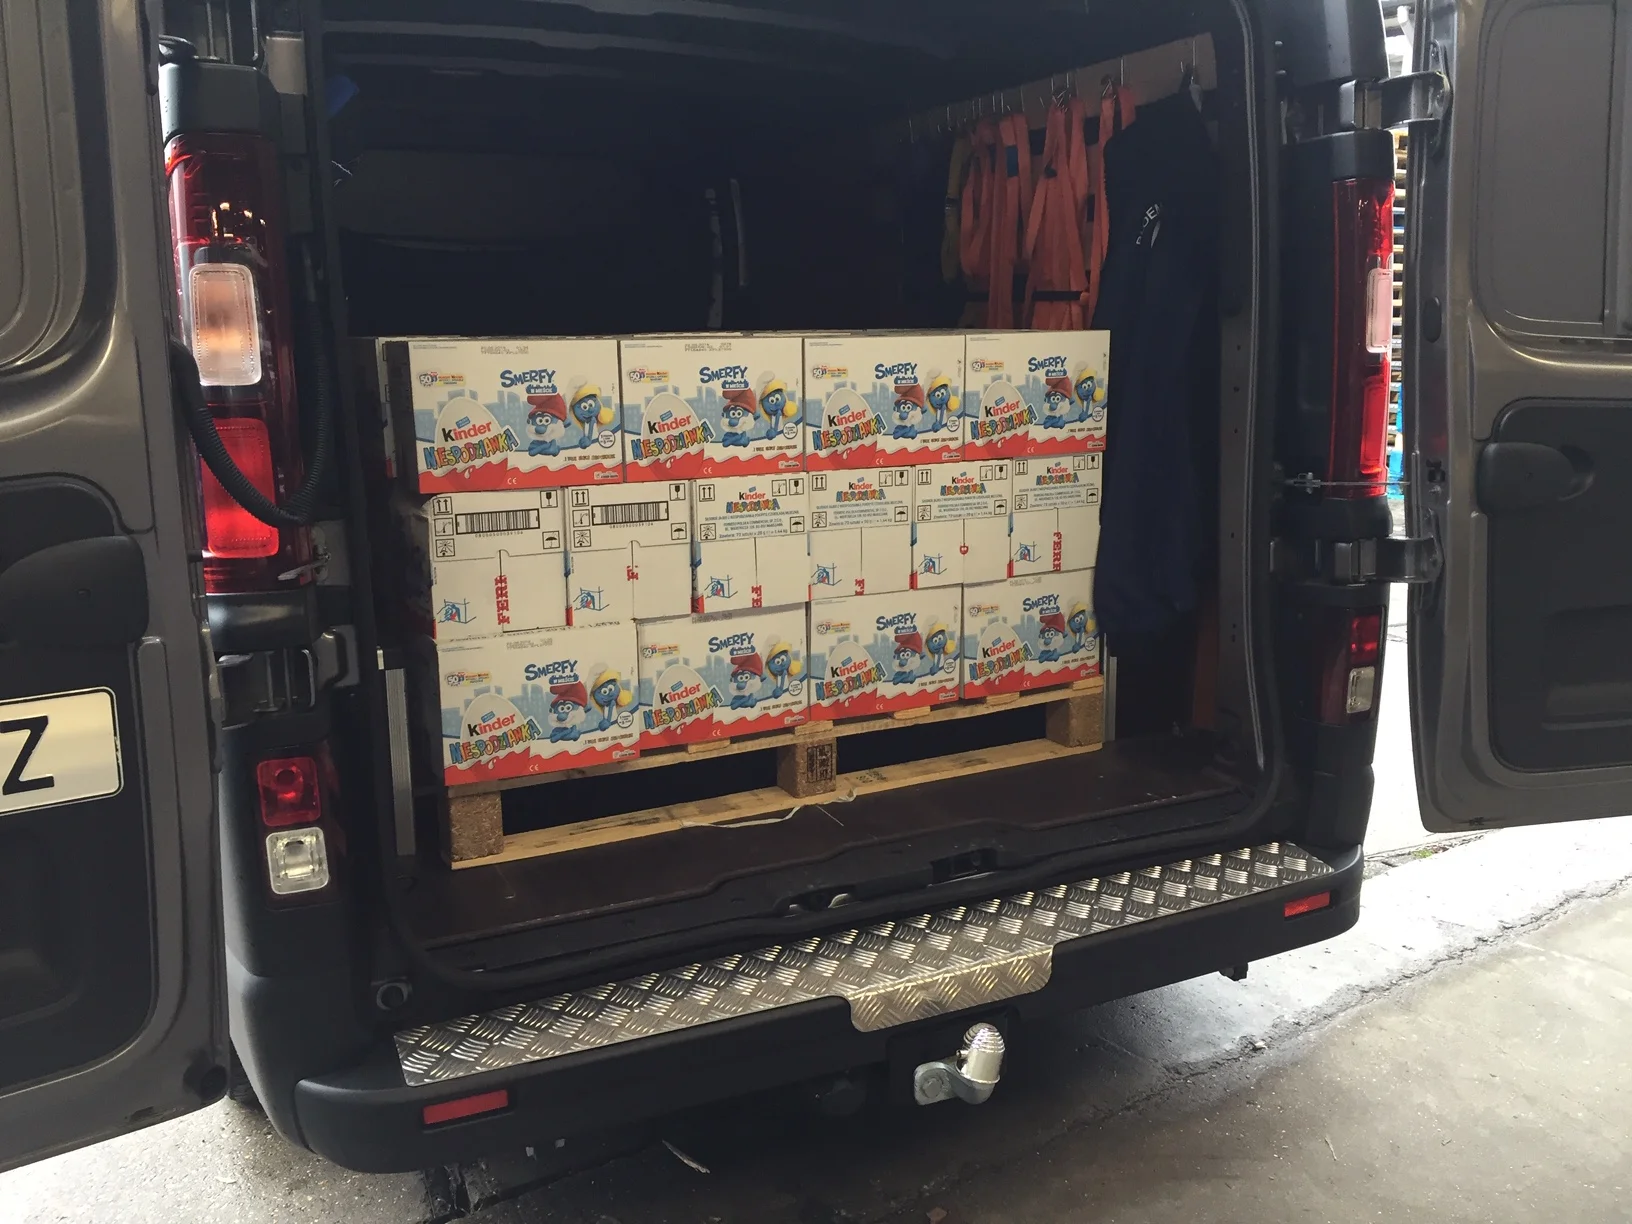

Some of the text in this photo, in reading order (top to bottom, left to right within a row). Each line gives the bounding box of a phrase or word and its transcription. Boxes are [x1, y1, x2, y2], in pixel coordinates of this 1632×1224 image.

[874, 362, 918, 379] SMERFY
[1028, 355, 1067, 372] SMERFY
[500, 369, 556, 388] SMERFY
[699, 365, 748, 384] SMERFY
[828, 408, 867, 427] kinder
[984, 400, 1020, 417] kinder
[441, 421, 492, 443] kinder
[647, 415, 692, 435] kinder
[812, 413, 887, 451] NIESPODZIANKA
[970, 404, 1037, 440] NIESPODZIANKA
[423, 428, 518, 470] NIESPODZIANKA
[631, 420, 714, 461] NIESPODZIANKA
[1023, 594, 1060, 612] SMERFY
[876, 612, 917, 631] SMERFY
[708, 632, 754, 653] SMERFY
[982, 638, 1016, 659] kinder
[524, 659, 578, 681] SMERFY
[830, 659, 868, 678] kinder
[968, 641, 1033, 681] NIESPODZIANKA
[815, 662, 886, 700] NIESPODZIANKA
[659, 683, 701, 704] kinder
[643, 686, 723, 729] NIESPODZIANKA
[467, 712, 516, 737] kinder
[449, 718, 541, 764] NIESPODZIANKA
[0, 715, 54, 795] Z
